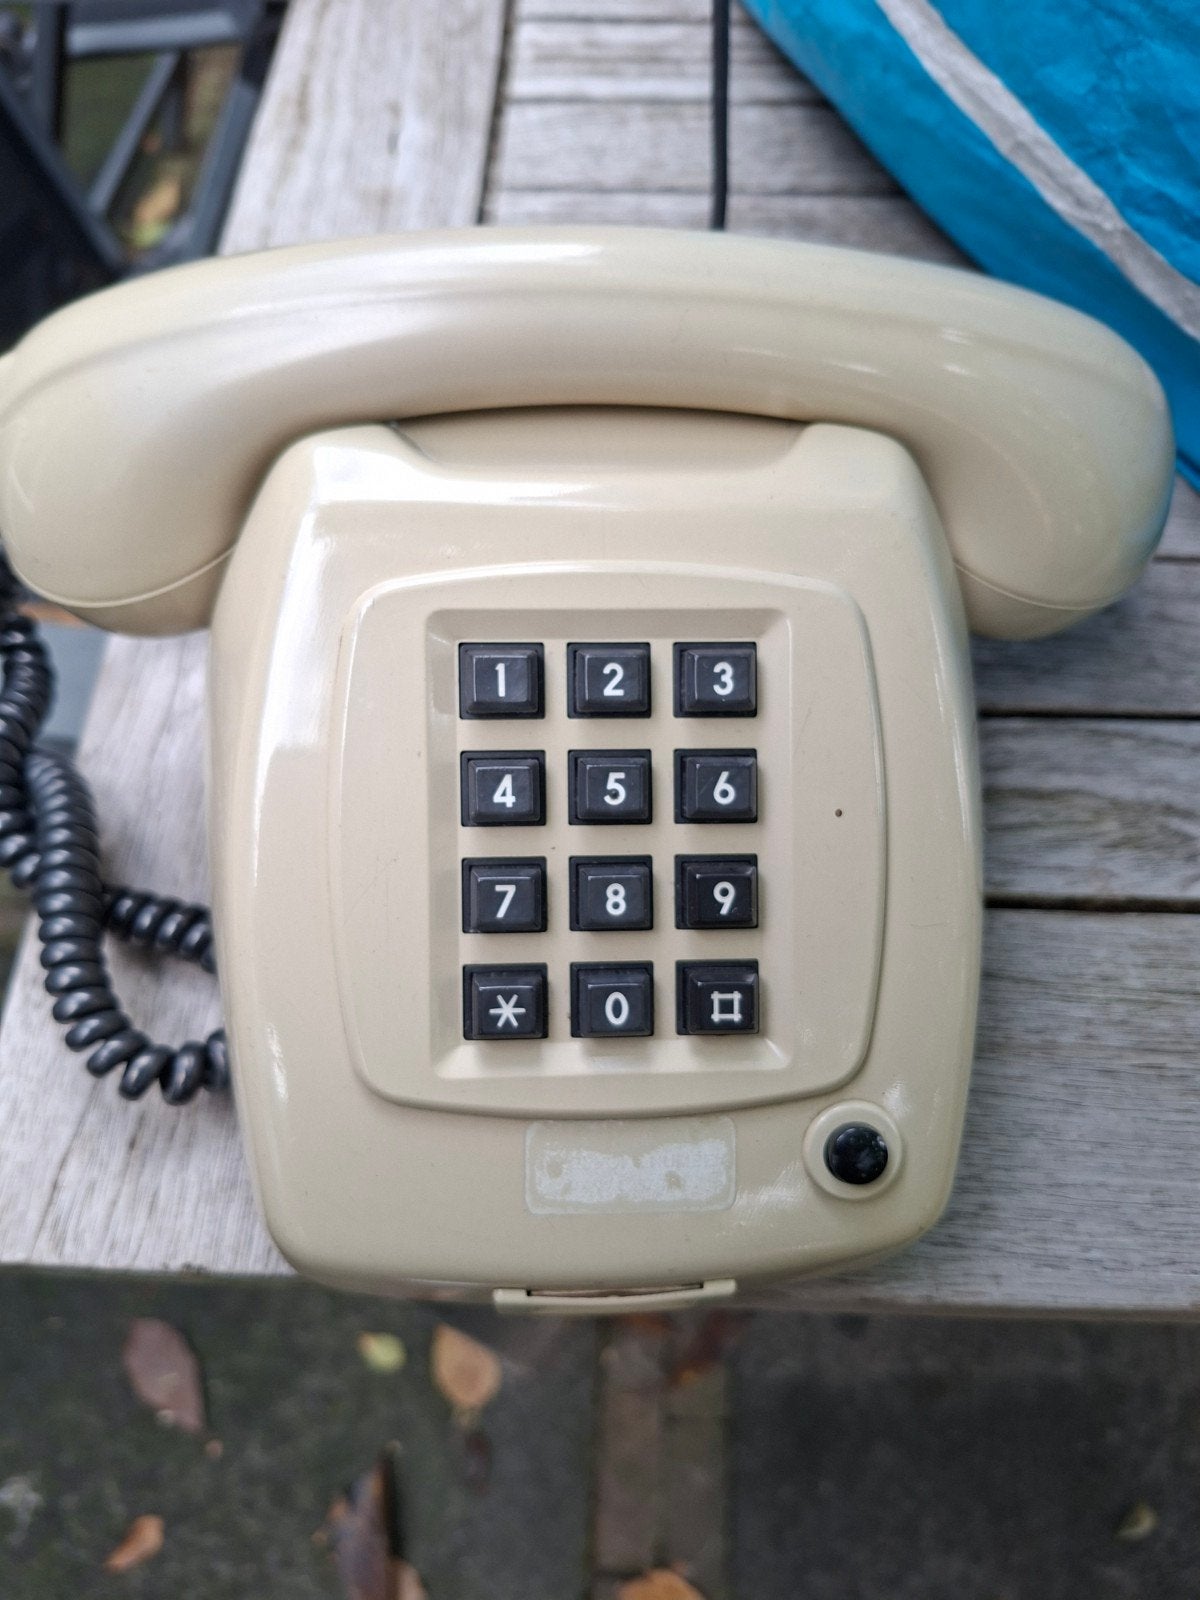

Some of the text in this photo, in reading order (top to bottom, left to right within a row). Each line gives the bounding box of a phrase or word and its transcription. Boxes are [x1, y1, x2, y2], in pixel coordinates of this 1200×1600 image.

[495, 663, 506, 697] 1
[602, 662, 625, 697] 2
[713, 661, 735, 696] 3
[493, 773, 517, 808] 4
[603, 771, 627, 806] 5
[713, 771, 736, 806] 6
[494, 884, 516, 919] 7
[605, 882, 627, 916] 8
[713, 881, 735, 916] 9
[605, 991, 629, 1026] 0
